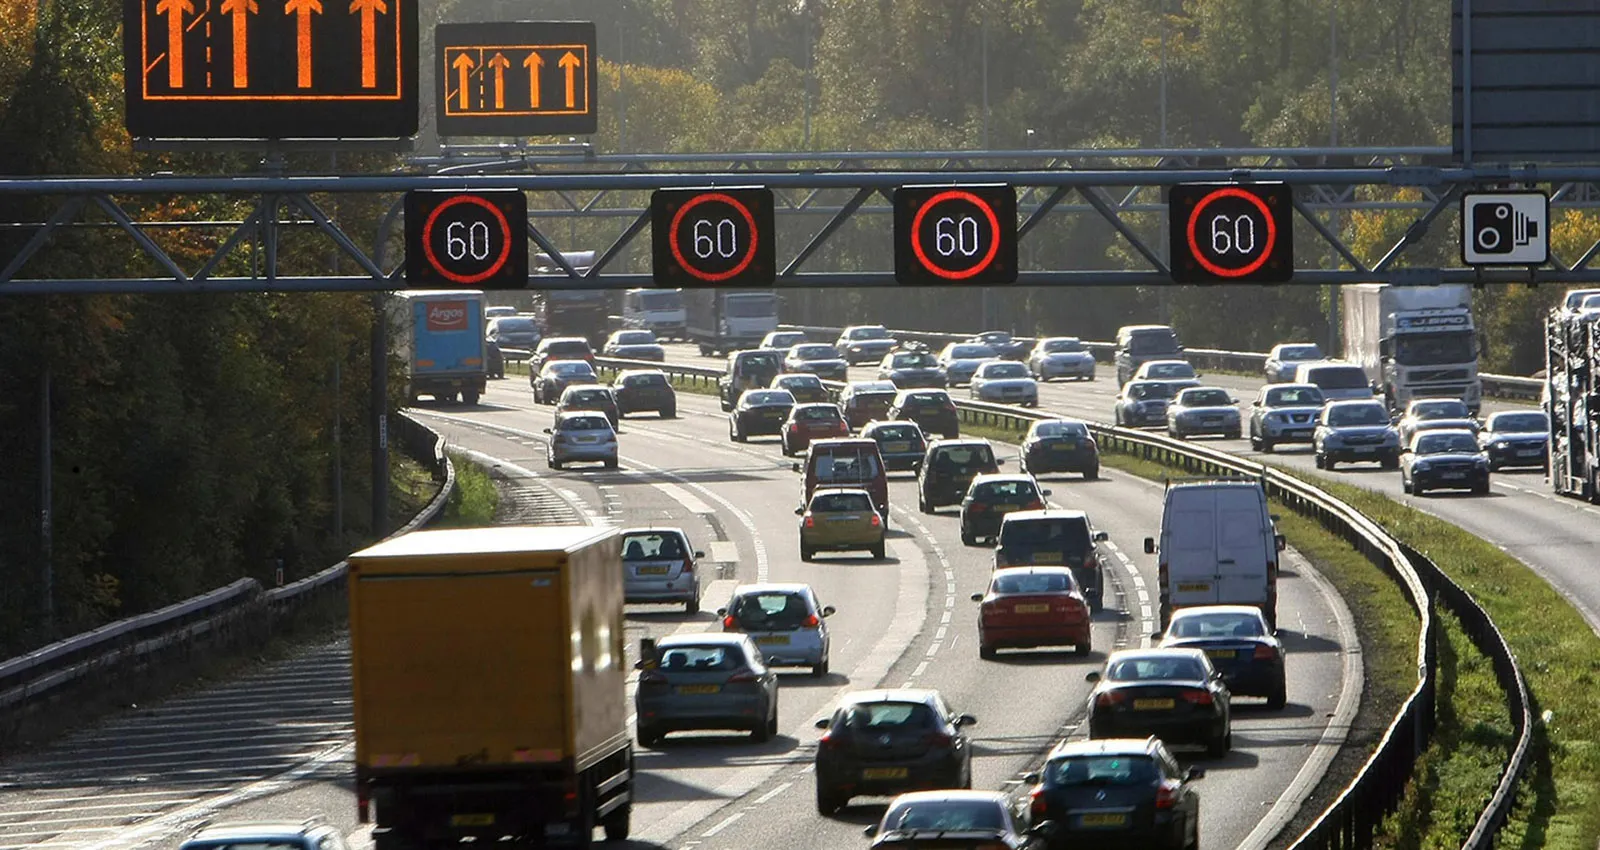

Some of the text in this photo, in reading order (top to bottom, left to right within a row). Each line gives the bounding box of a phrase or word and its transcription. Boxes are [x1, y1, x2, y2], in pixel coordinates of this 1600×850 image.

[447, 221, 489, 260] 60
[694, 218, 737, 258] 60
[936, 216, 978, 256] 60
[1211, 214, 1254, 253] 60
[429, 306, 464, 320] Argos
